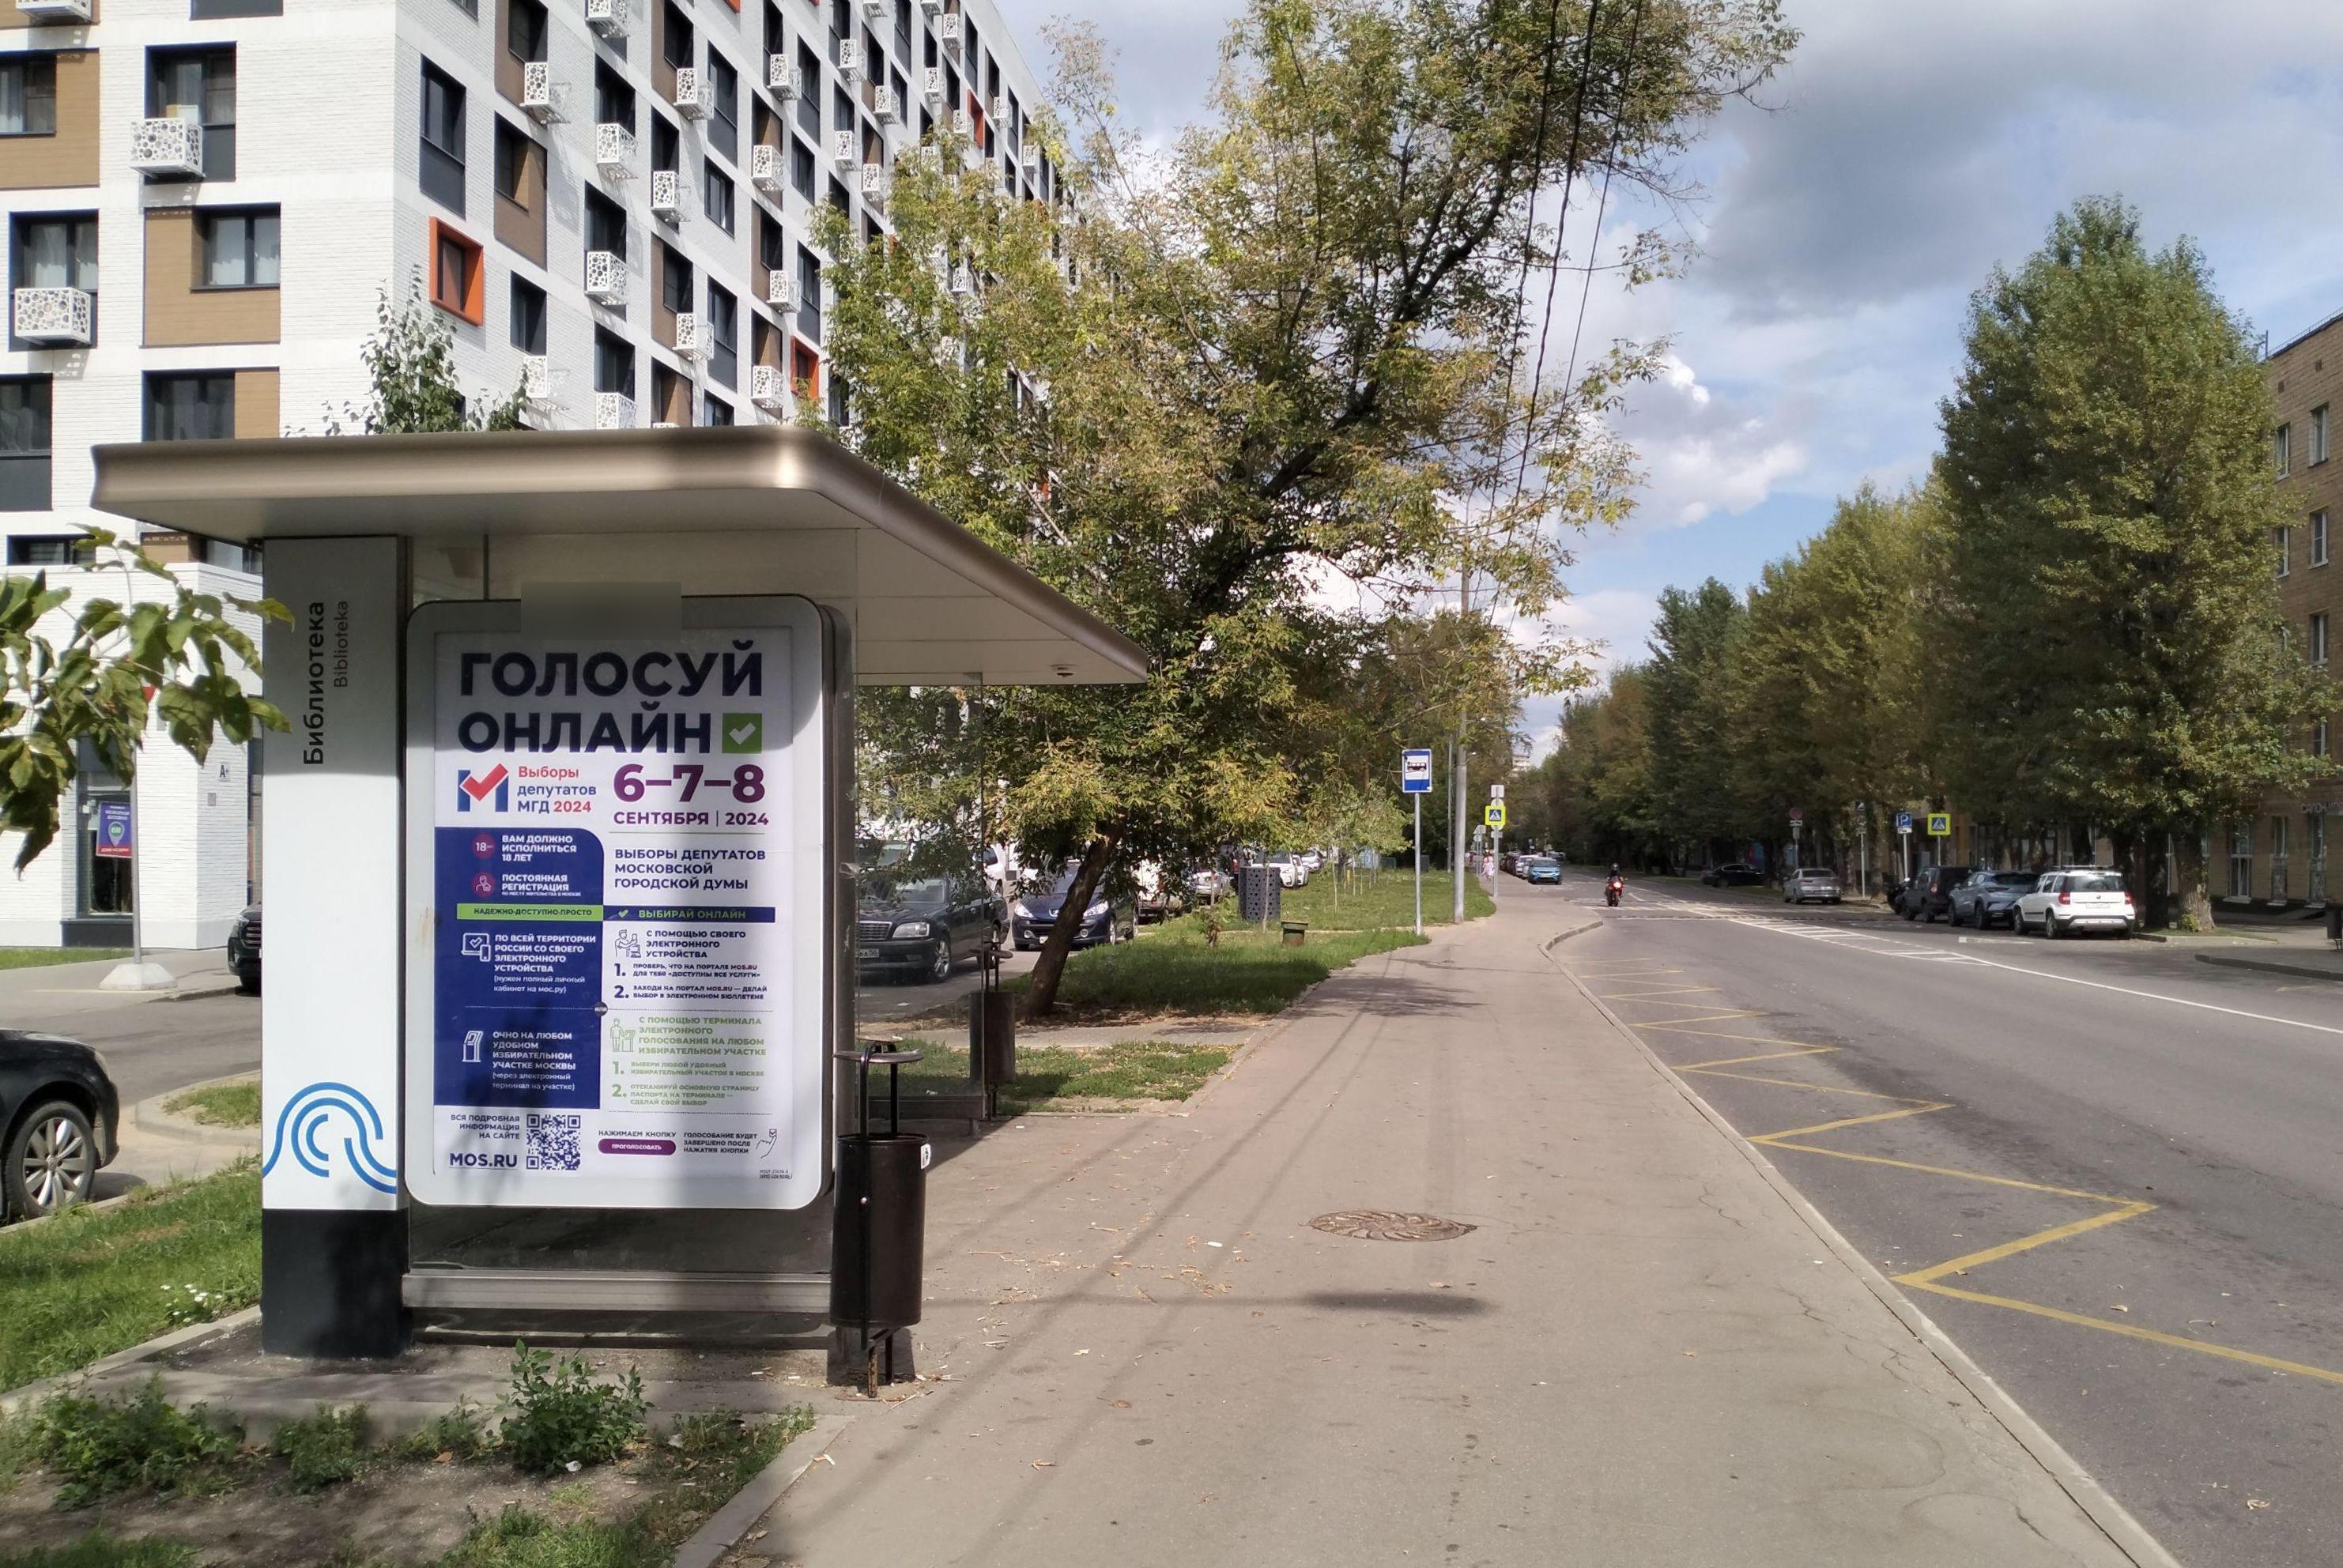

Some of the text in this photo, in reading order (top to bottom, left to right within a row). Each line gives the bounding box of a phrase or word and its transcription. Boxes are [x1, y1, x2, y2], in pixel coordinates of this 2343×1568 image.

[334, 601, 348, 688] Biblioteka
[460, 639, 762, 696] ГОЛОСУЙ
[303, 601, 324, 765] Библиотека
[458, 701, 711, 754] ОНЛАЙН
[518, 766, 579, 781] Выборы
[517, 786, 597, 797] депутатов
[518, 801, 591, 814] МГД 2024
[613, 812, 769, 825] СЕНТЯБРЯ 2024
[526, 835, 573, 844] ДОЛЖНО
[615, 849, 765, 861] ВЫБОРЫ ДЕПУТАТОВ
[614, 862, 713, 874] МОСКОВСКОЙ
[502, 884, 569, 892] РЕГИСТРАЦИЯ
[614, 876, 748, 891] ГОРОДСКОЙ ДУМЫ
[639, 907, 745, 919] ВЫБИРАЙ ОНЛАЙН
[510, 933, 534, 942] ВСЕЙ
[646, 949, 707, 958] УСТРОЙСТВА
[494, 963, 553, 972] УСТРОЙСТВА
[613, 963, 626, 977] 1.
[614, 985, 629, 998] 2.
[613, 1061, 624, 1075] 1.
[612, 1084, 627, 1097] 2.
[450, 1152, 518, 1167] MOS.RU
